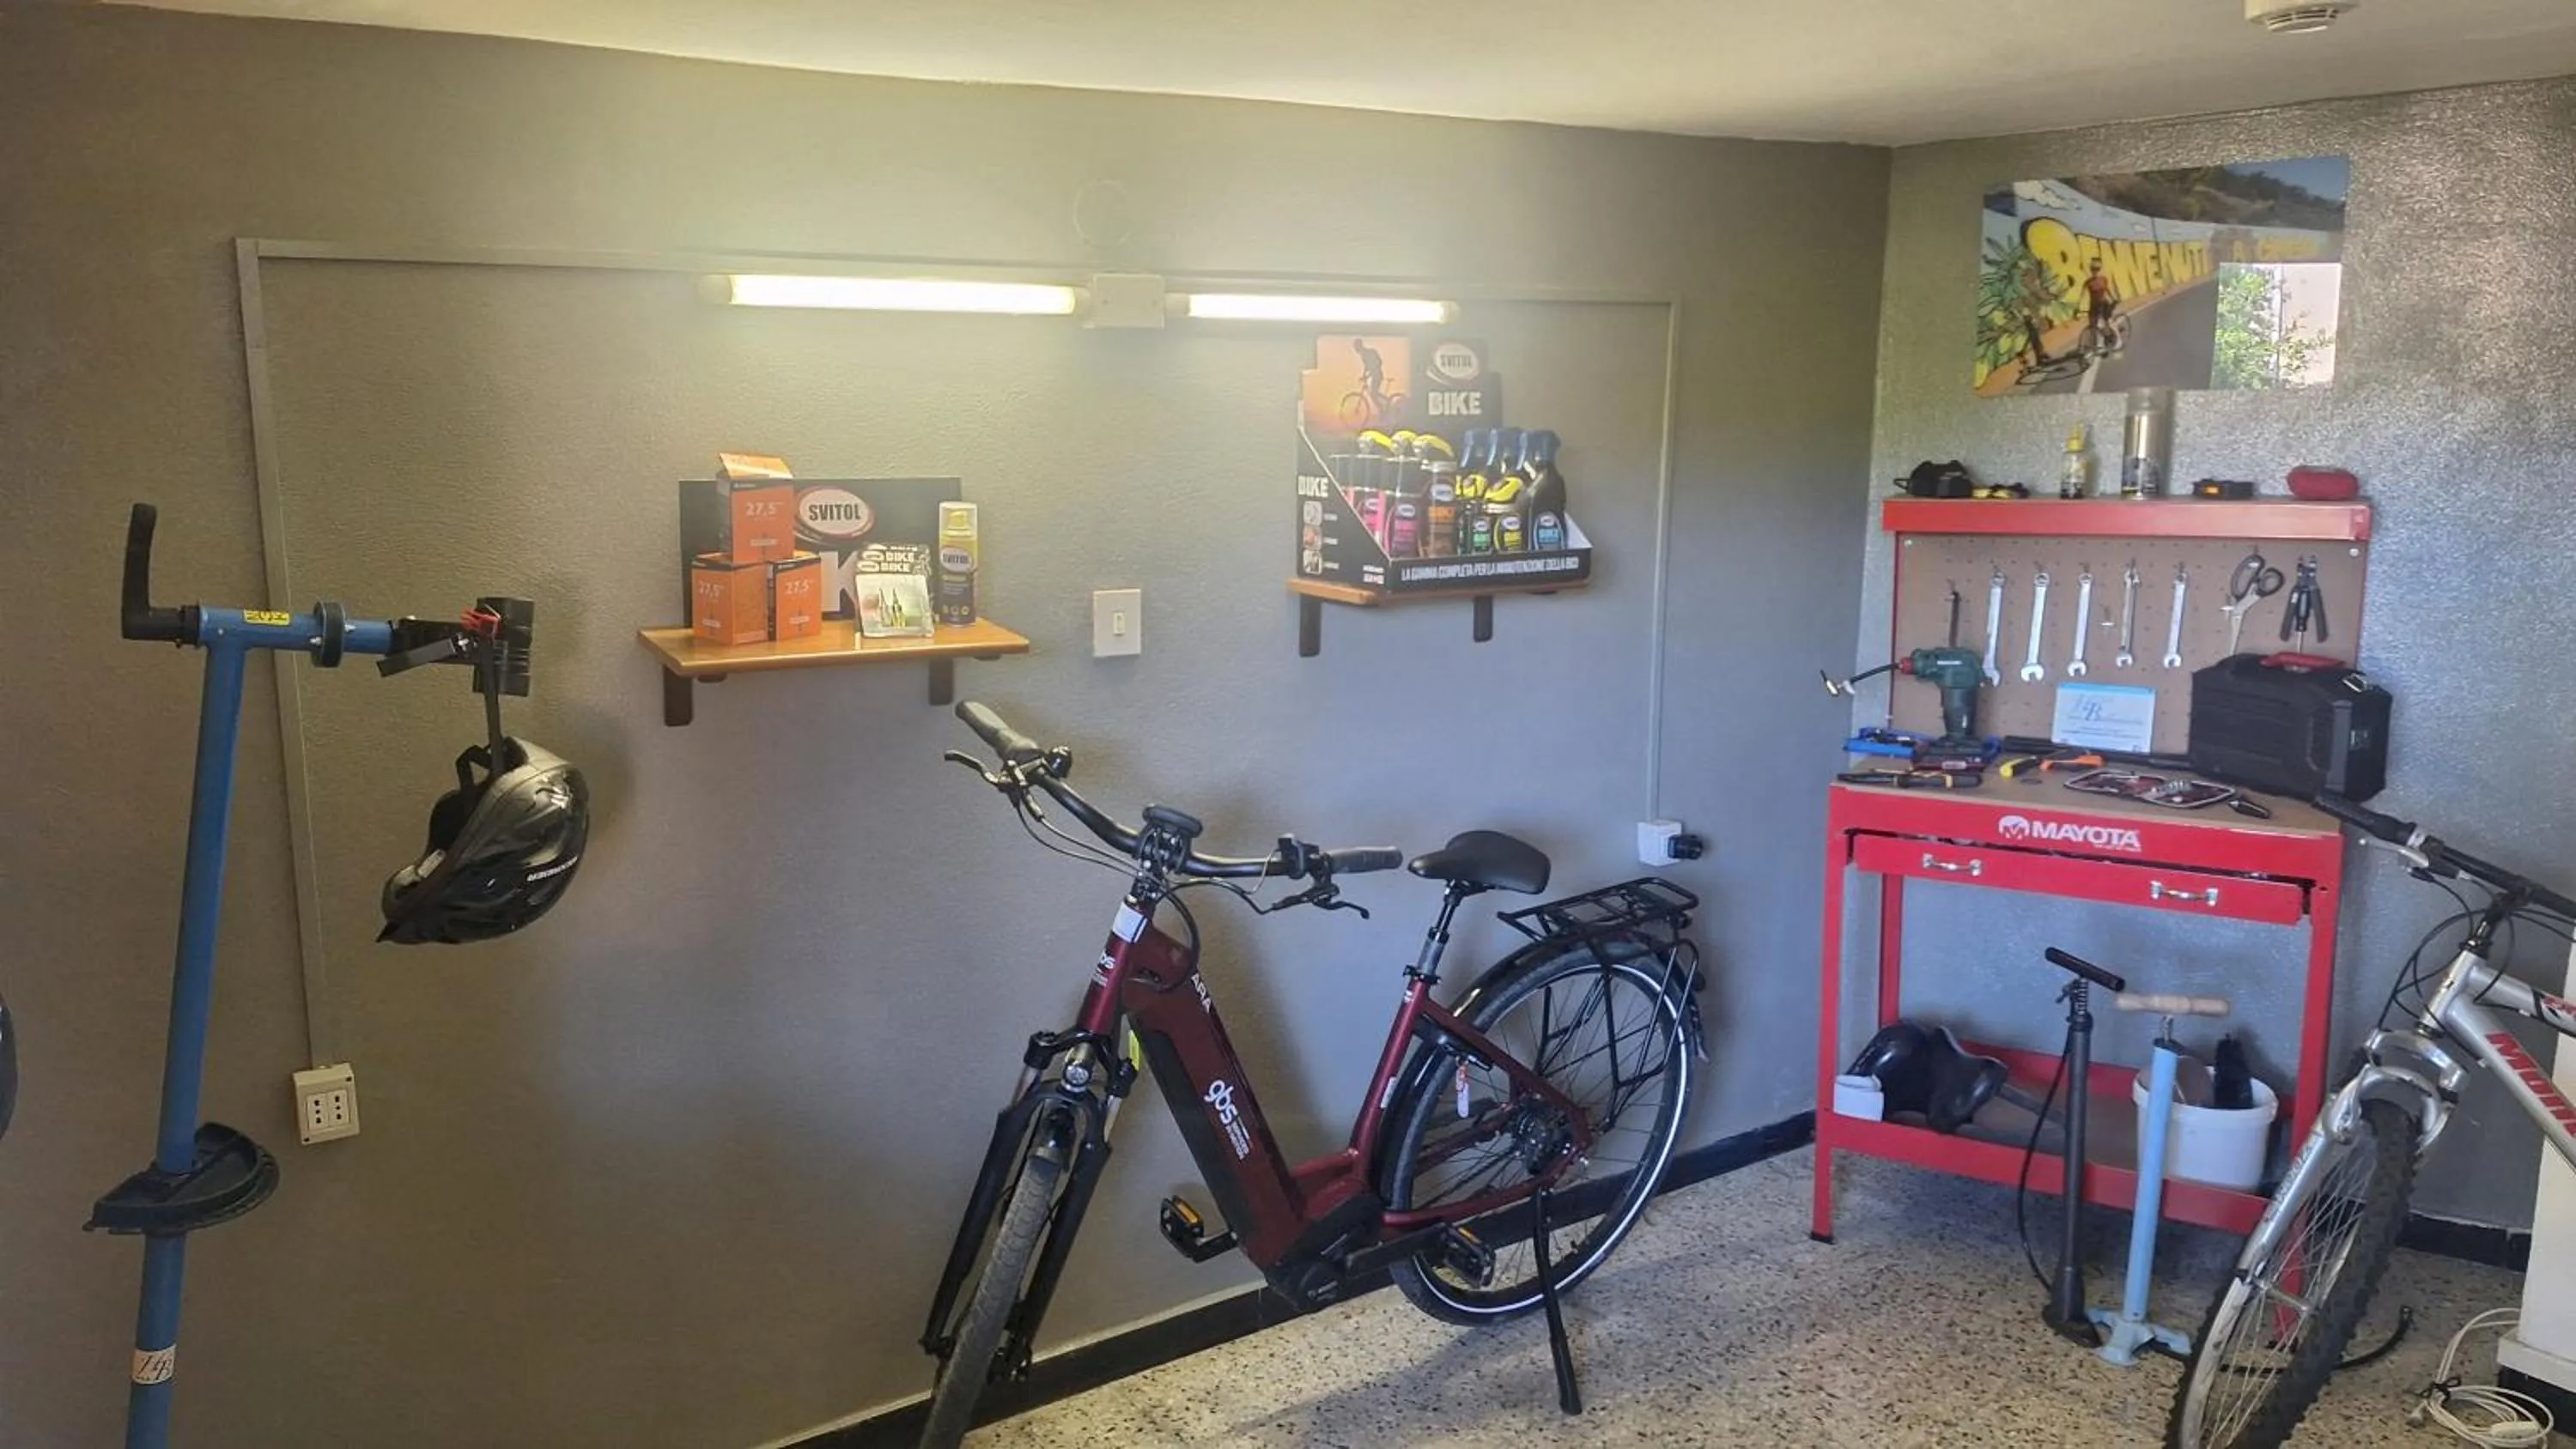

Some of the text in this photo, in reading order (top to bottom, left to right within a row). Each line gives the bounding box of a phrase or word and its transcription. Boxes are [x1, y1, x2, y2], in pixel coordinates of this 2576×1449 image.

[1428, 391, 1482, 415] BIKE
[1297, 475, 1329, 498] BIKE
[809, 503, 862, 522] SVITOL
[2031, 821, 2142, 848] MAYOTA
[1204, 1079, 1238, 1125] gbs
